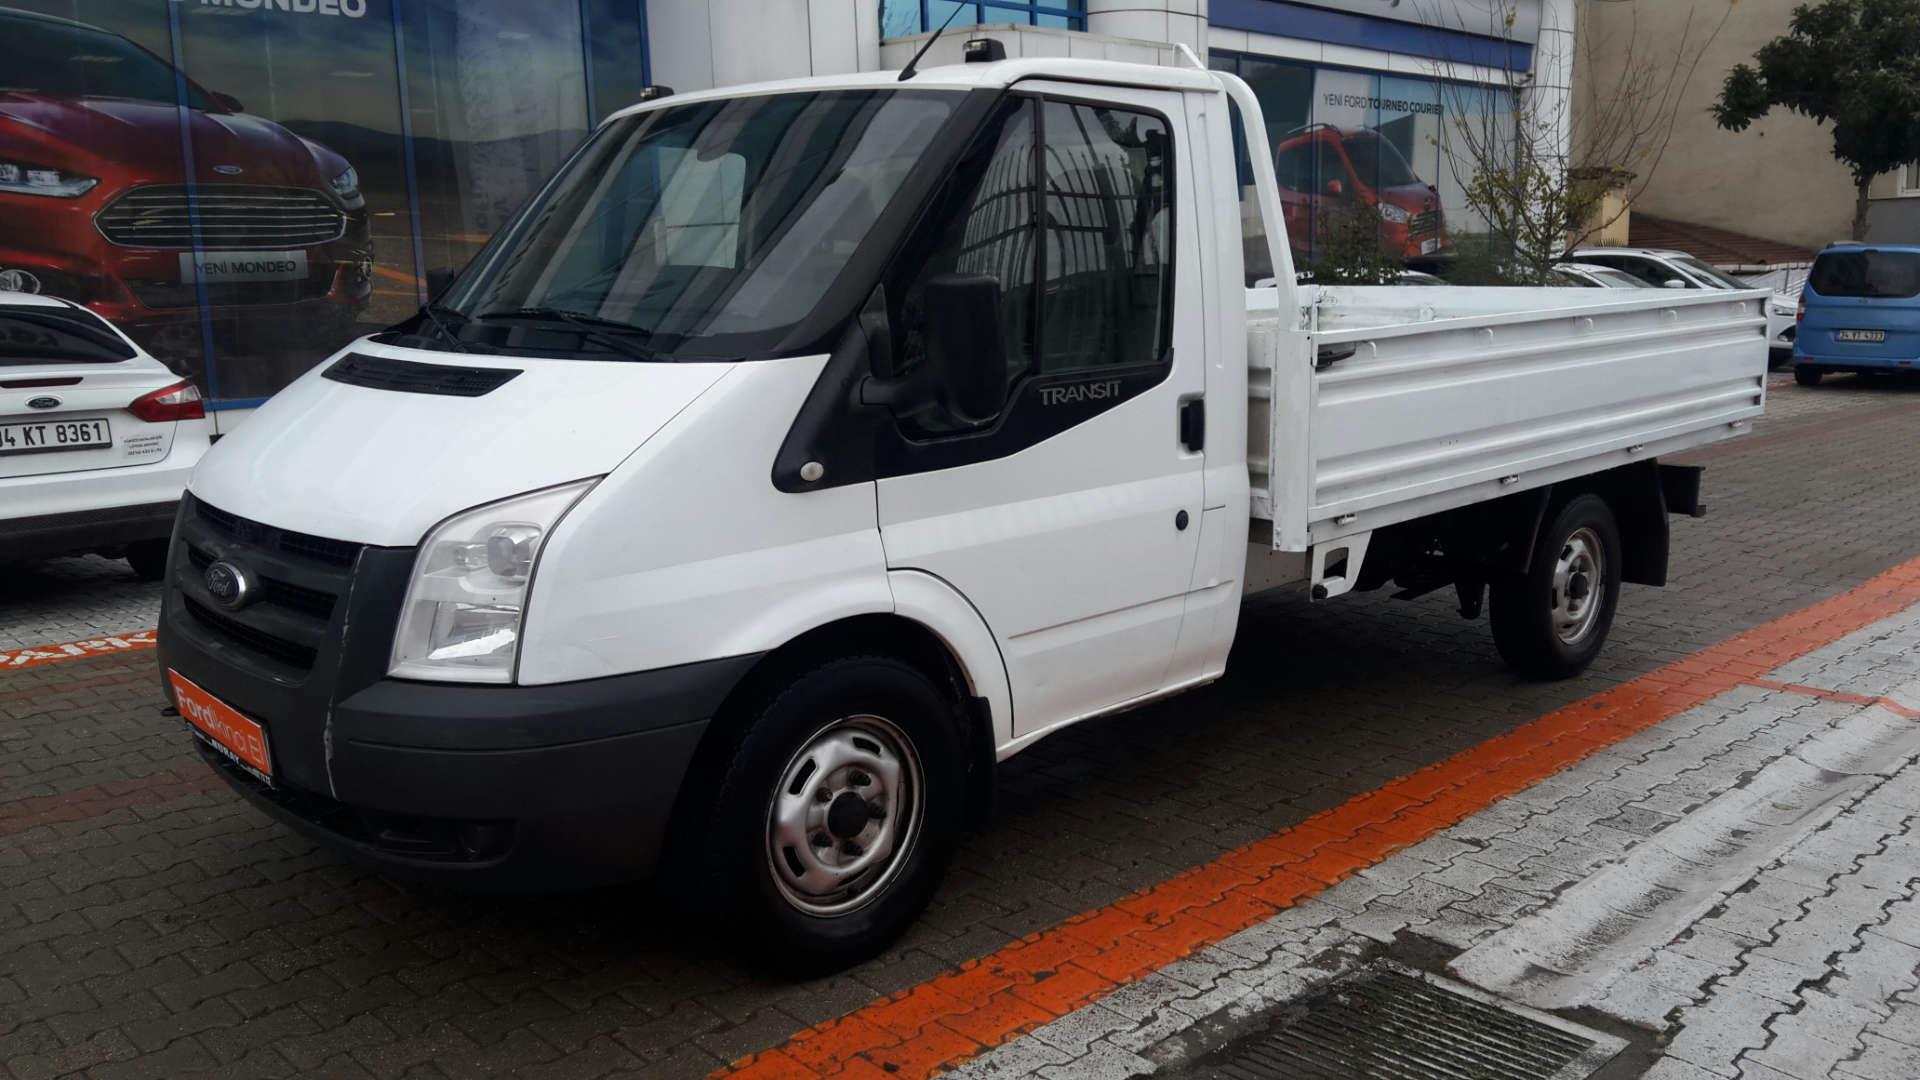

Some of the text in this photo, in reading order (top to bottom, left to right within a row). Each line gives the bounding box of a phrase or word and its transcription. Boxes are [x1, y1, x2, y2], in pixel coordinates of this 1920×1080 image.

[1344, 94, 1367, 109] FORD
[231, 261, 297, 274] MONDEO
[1040, 381, 1121, 406] TRANSIT
[0, 422, 102, 448] 4 KT 8361
